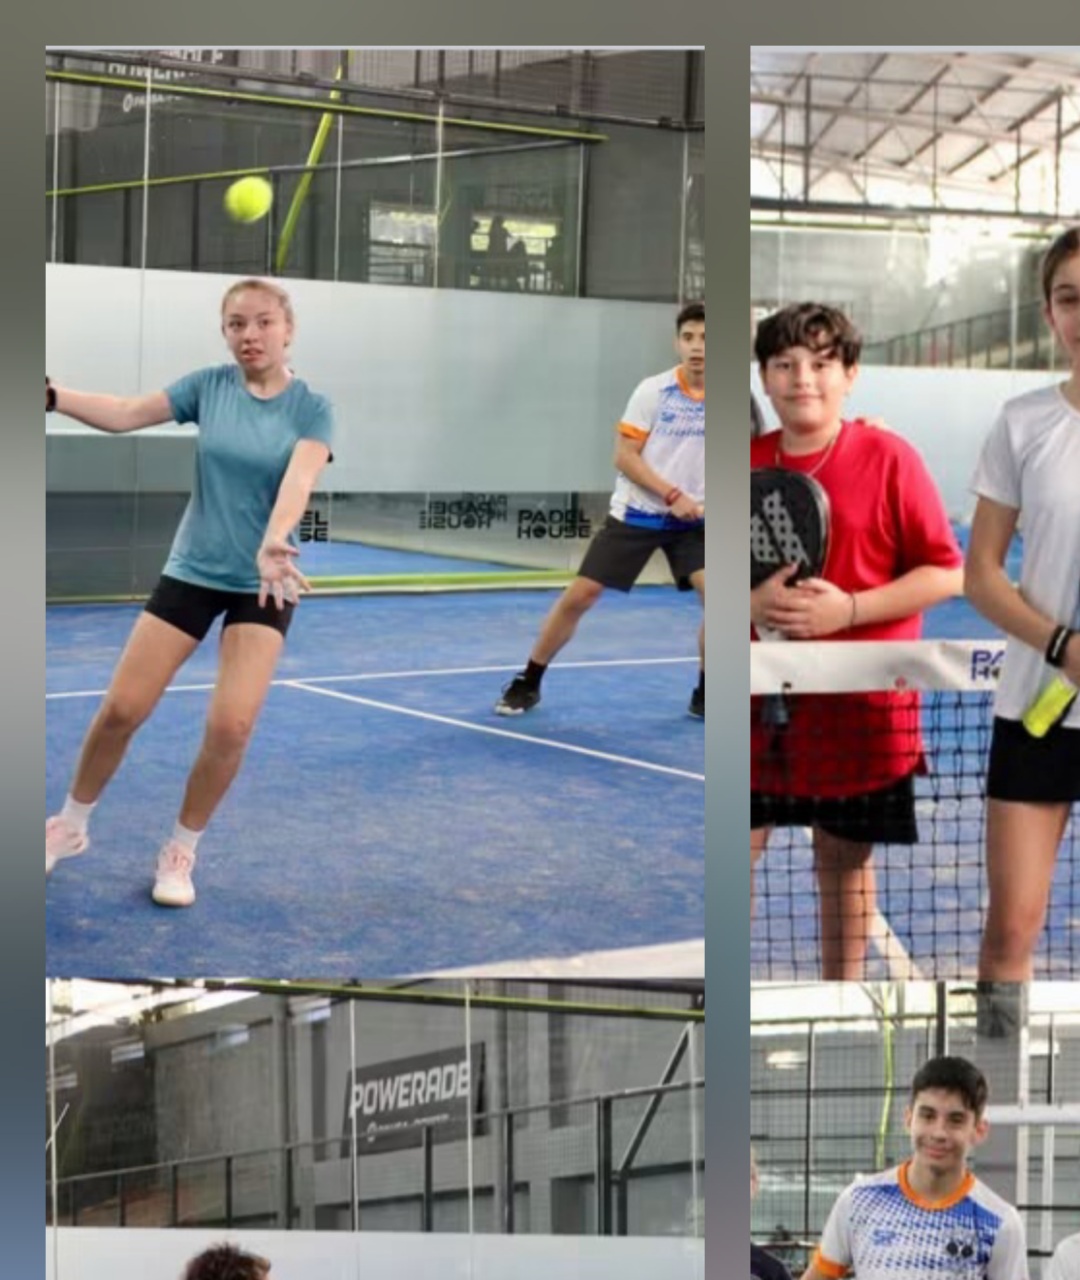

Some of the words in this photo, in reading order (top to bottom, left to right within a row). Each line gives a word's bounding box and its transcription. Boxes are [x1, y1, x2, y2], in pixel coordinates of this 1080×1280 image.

[517, 508, 590, 524] PADEL
[517, 525, 591, 539] HOUSE
[349, 1060, 471, 1119] POWERADE
